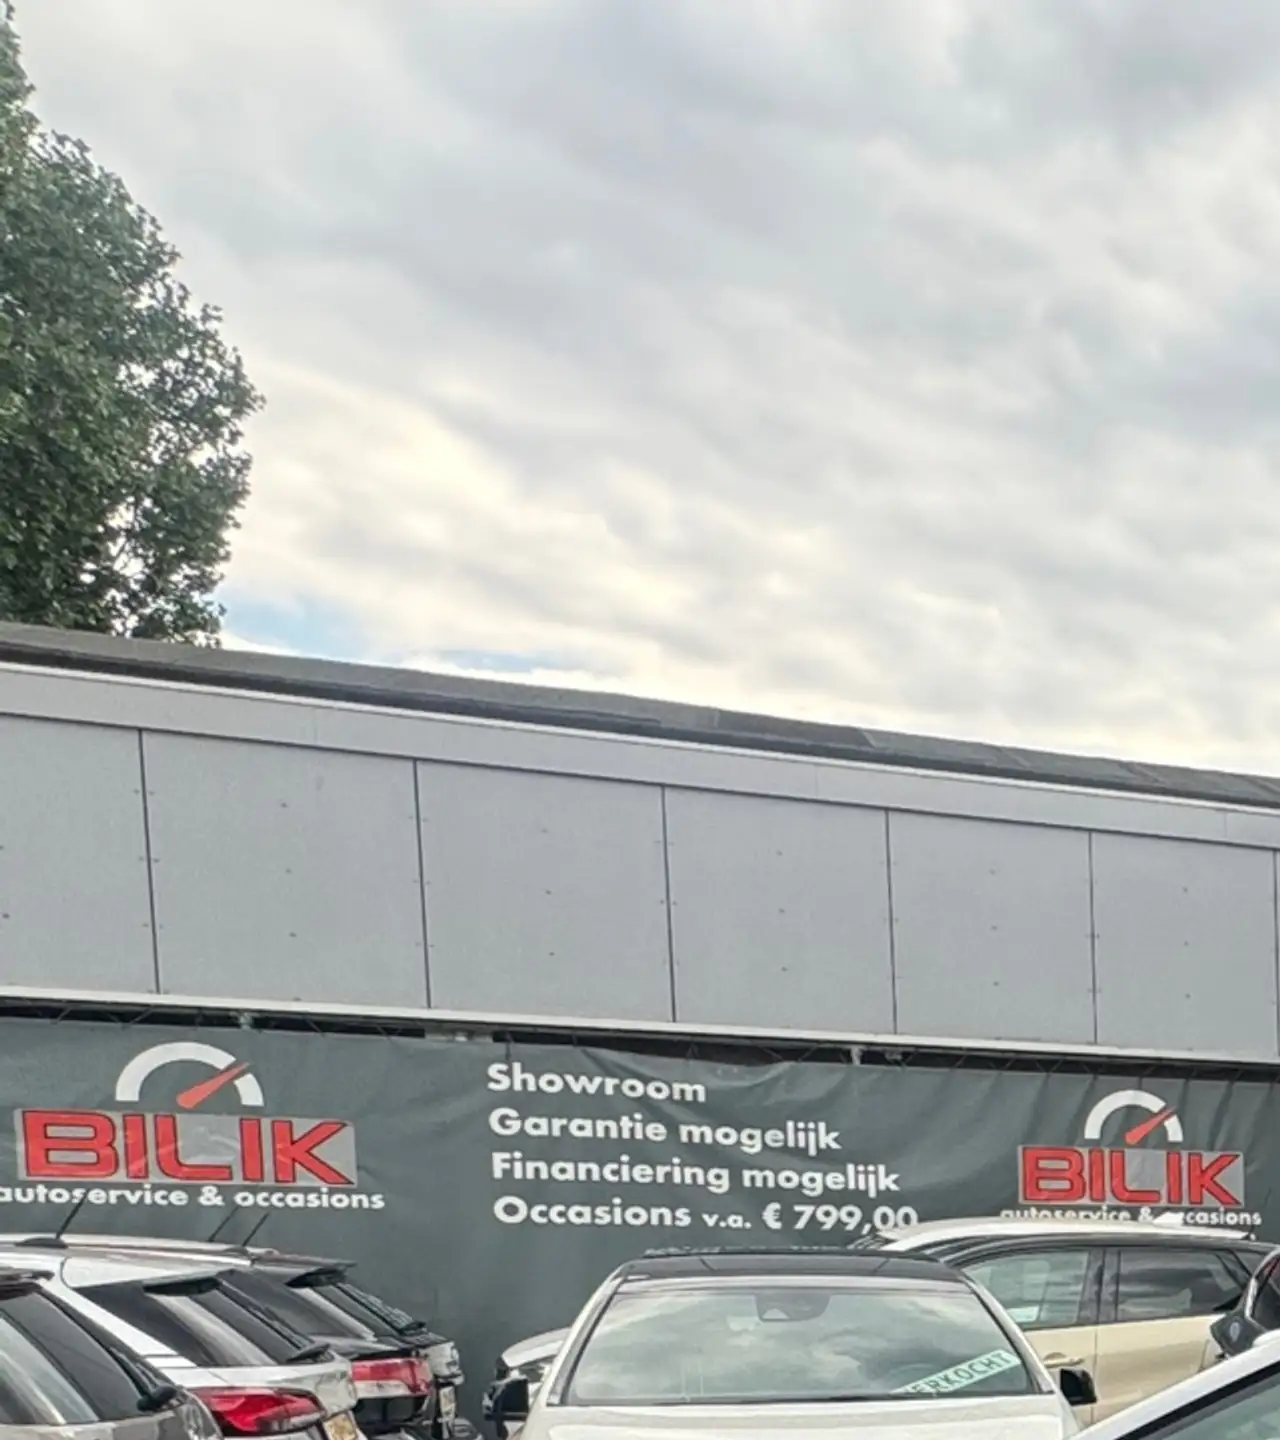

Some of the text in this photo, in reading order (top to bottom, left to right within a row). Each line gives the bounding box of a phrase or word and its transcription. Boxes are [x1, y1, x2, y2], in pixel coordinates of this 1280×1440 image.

[487, 1062, 706, 1102] Showroom
[22, 1110, 355, 1185] BILIK
[489, 1107, 842, 1156] Garantie mogelijk
[199, 1186, 225, 1207] &
[234, 1187, 385, 1209] occasions
[491, 1151, 901, 1198] Financiering mogelijk
[1022, 1146, 1242, 1206] BILIK
[493, 1195, 918, 1235] Occasions v.a. € 799,00
